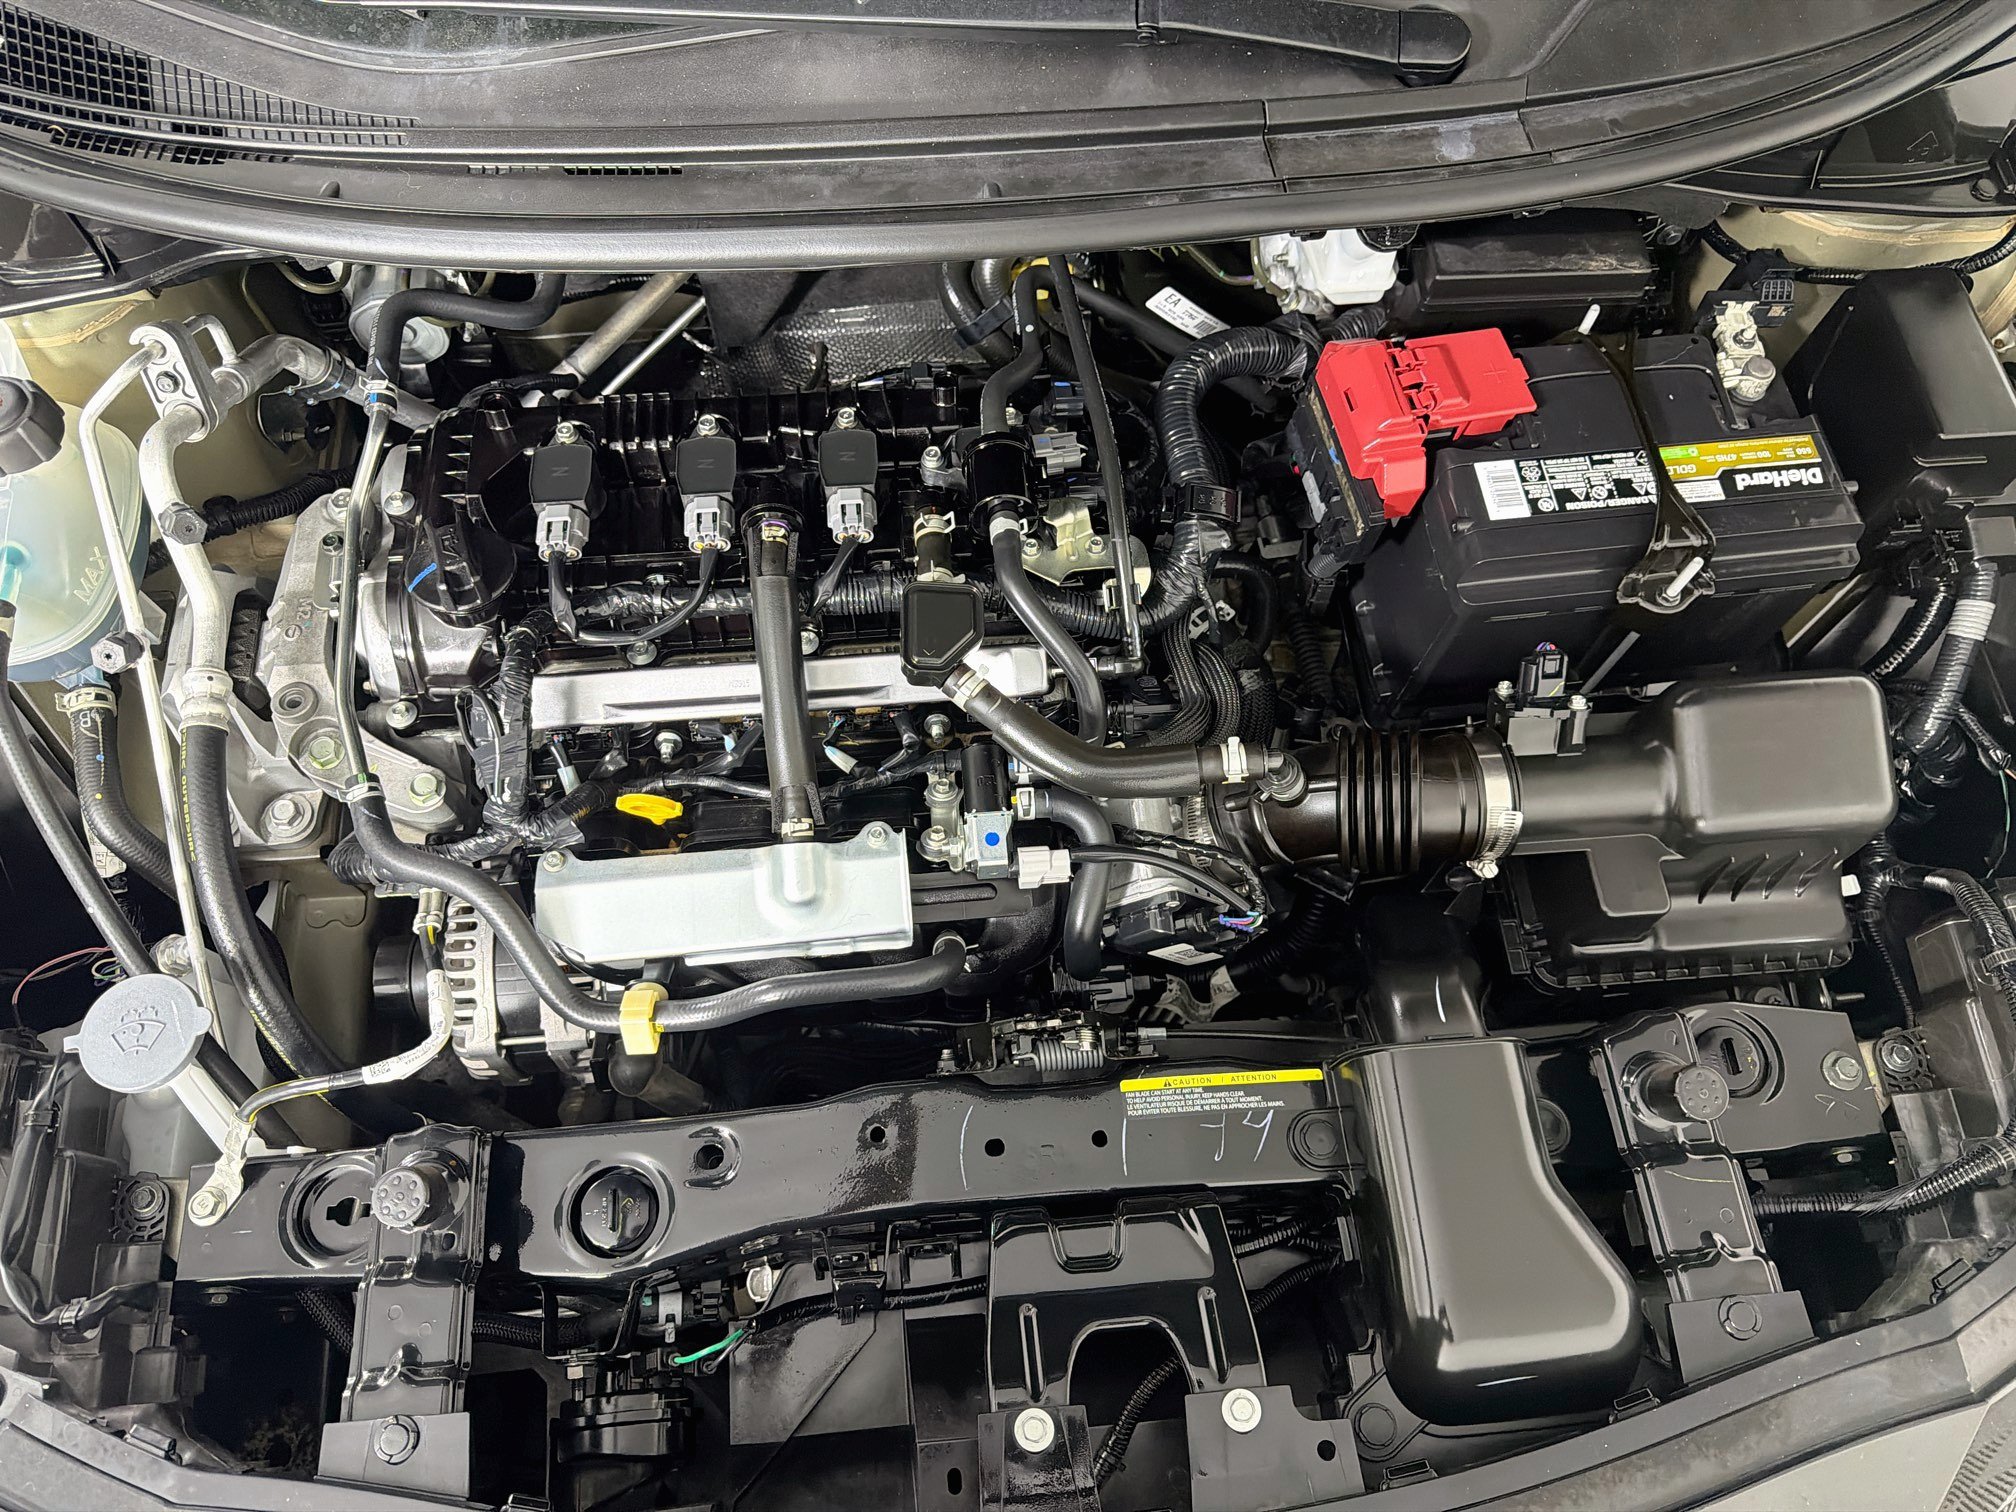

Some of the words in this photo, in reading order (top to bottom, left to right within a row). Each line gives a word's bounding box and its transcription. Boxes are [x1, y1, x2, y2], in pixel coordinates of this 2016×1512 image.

[1164, 293, 1182, 308] EA
[1757, 450, 1772, 458] 100
[1796, 447, 1812, 455] 650
[1735, 467, 1823, 490] DieHard
[1565, 496, 1649, 509] DANGER/POISON
[73, 546, 108, 605] MAX
[1172, 1076, 1212, 1086] CAUTION
[1231, 1074, 1277, 1082] ATTENTION
[1134, 1101, 1166, 1109] VENTILATEUR
[1194, 1096, 1220, 1105] DÉMARRER
